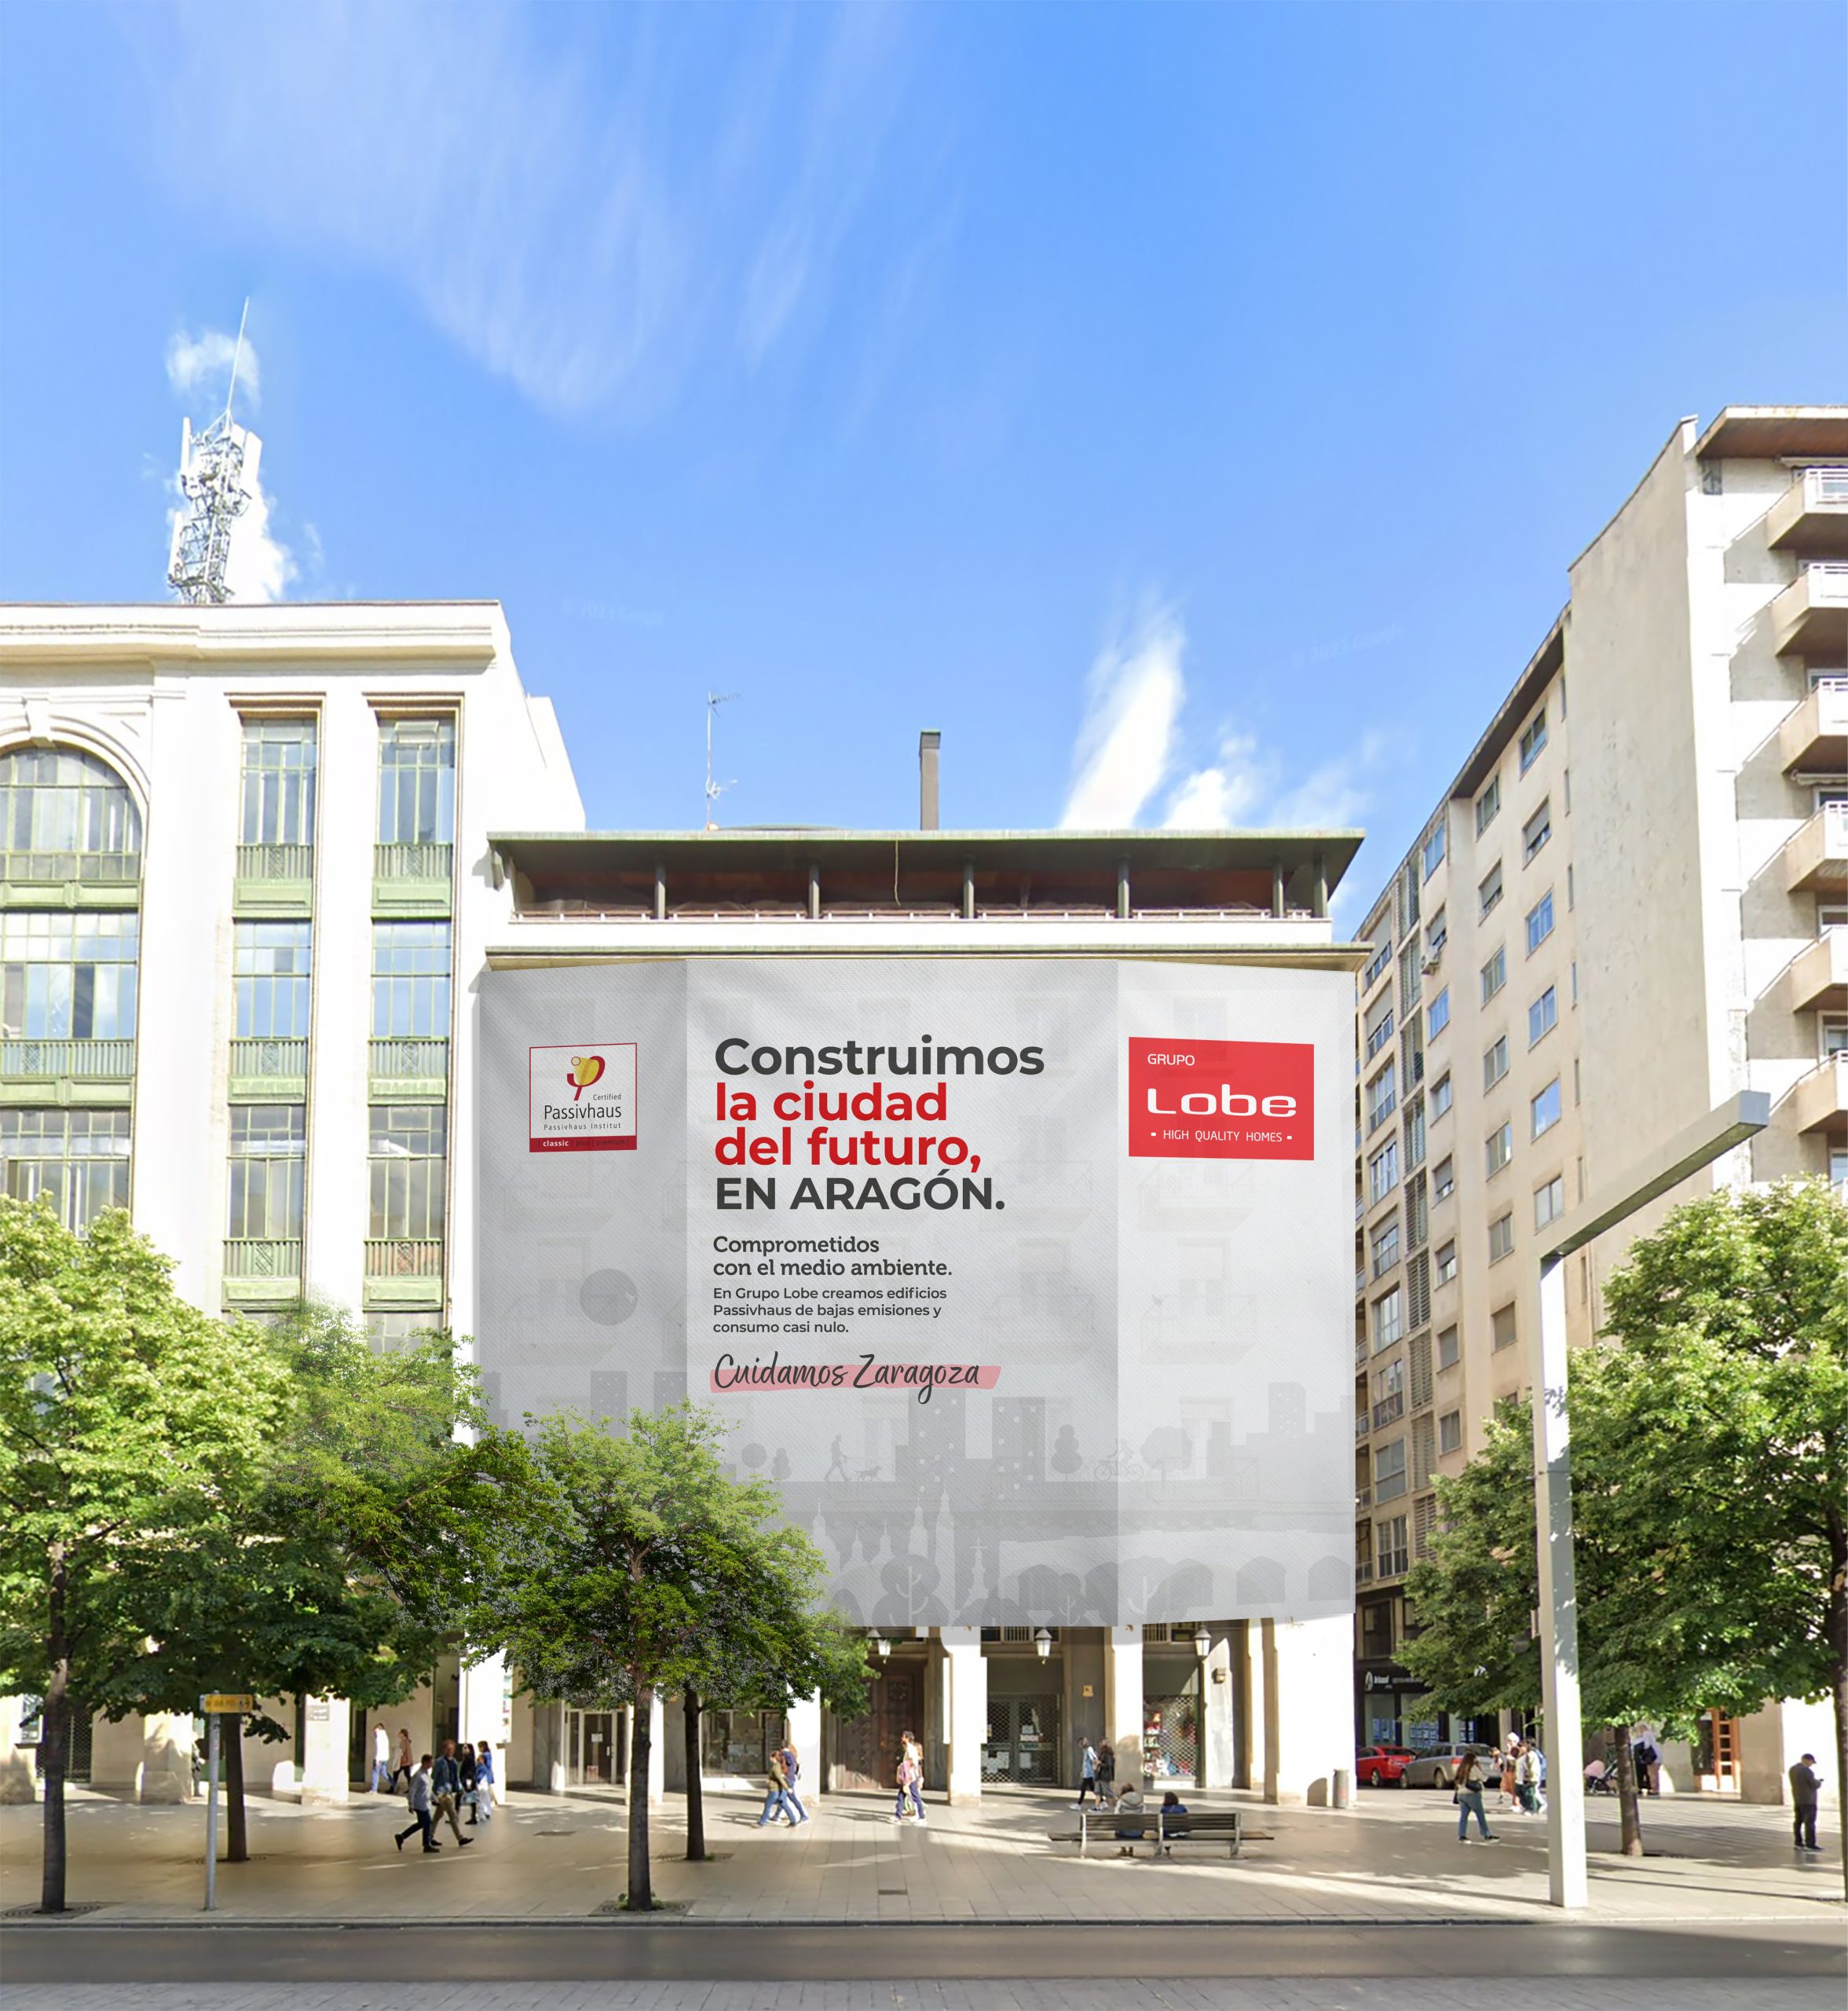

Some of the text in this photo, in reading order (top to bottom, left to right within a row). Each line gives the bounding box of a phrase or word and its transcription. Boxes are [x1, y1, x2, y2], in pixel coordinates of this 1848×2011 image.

[715, 1034, 1045, 1075] Construimos
[1147, 1053, 1195, 1066] GRUPO
[716, 1079, 947, 1122] la ciudad
[1147, 1083, 1297, 1118] Lobe
[544, 1102, 622, 1120] Passivhaus
[1163, 1130, 1283, 1142] HIGH QUALITY HOMES
[715, 1126, 981, 1174] del futuro,
[716, 1168, 1005, 1211] EN ARAGÓN.
[713, 1236, 880, 1257] Comprometidos
[713, 1258, 952, 1276] con el medio ambiente.
[713, 1287, 947, 1302] En Grupo Lobe creamos edificios
[713, 1303, 942, 1319] Passivhaus de bajas emisiones y
[712, 1321, 849, 1333] consumo casi nulo.
[714, 1350, 979, 1405] Cuidamos Zaragoza
